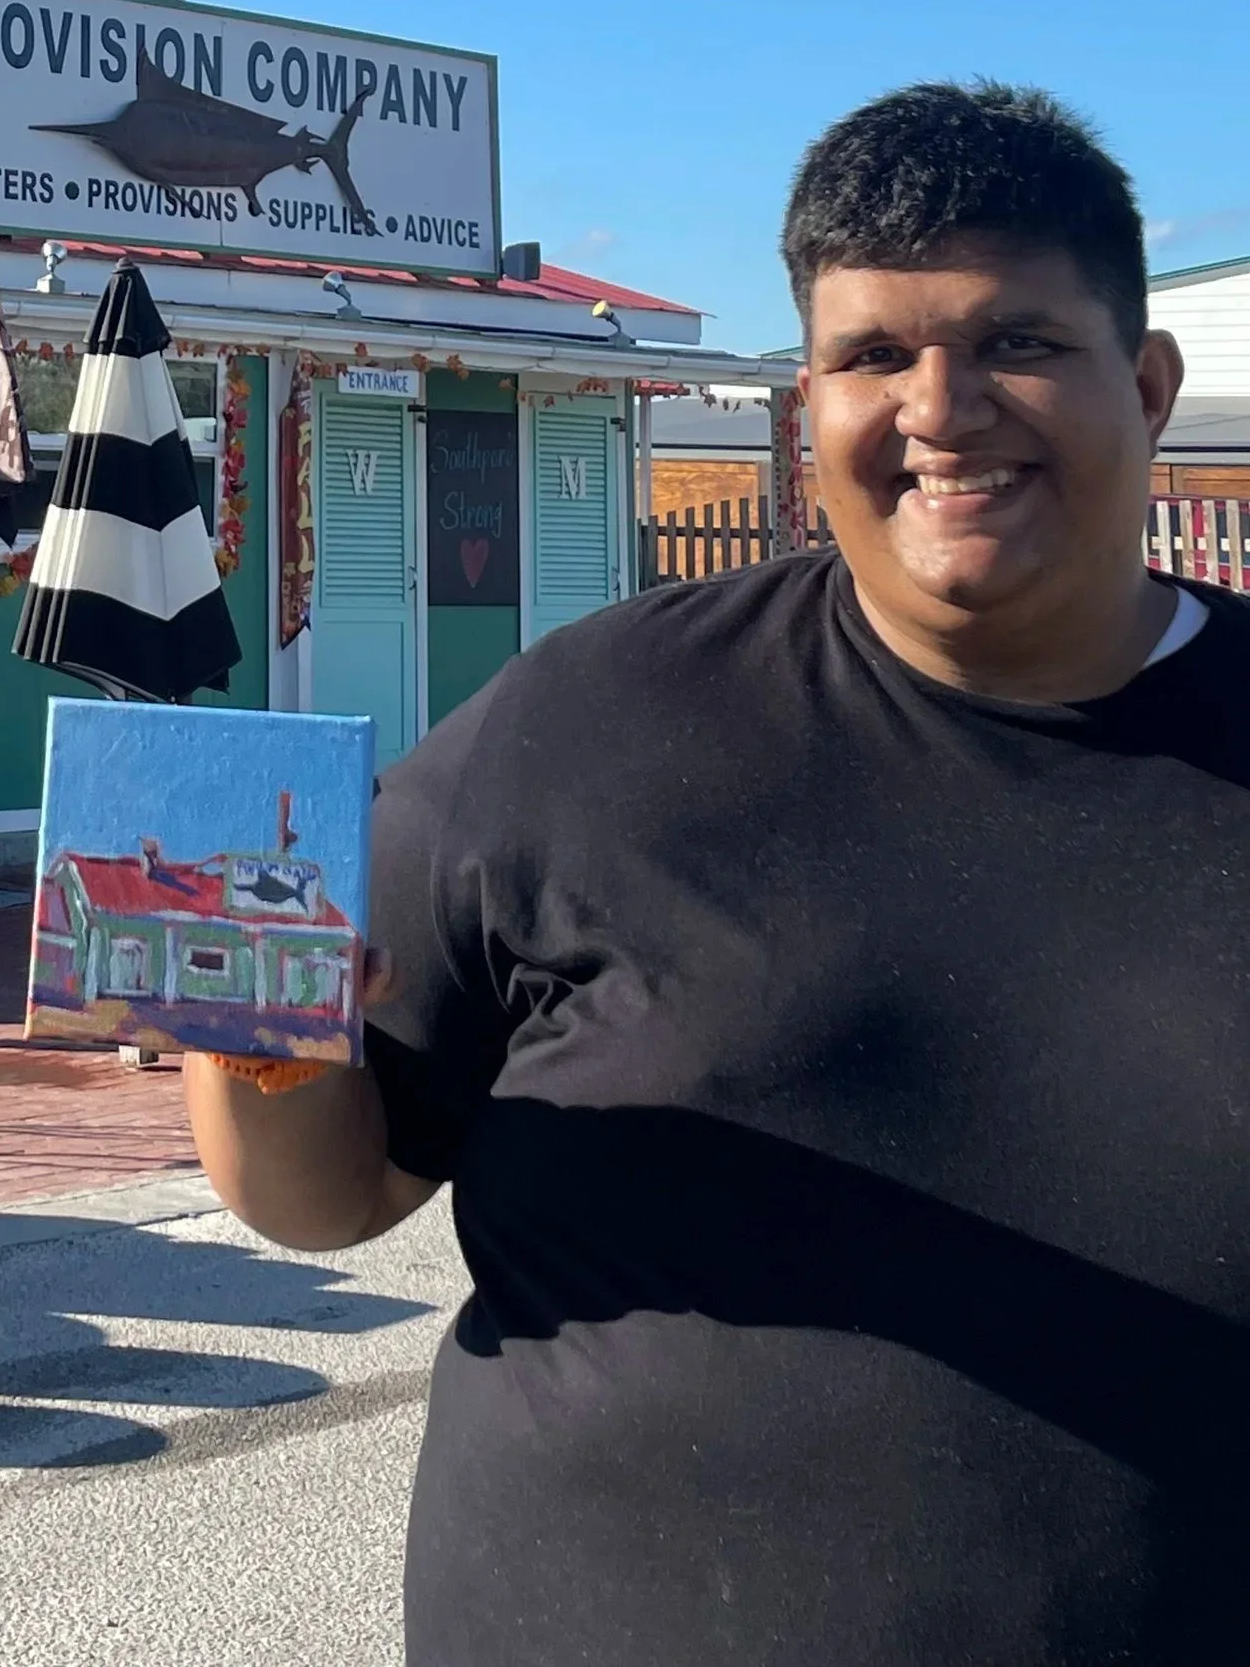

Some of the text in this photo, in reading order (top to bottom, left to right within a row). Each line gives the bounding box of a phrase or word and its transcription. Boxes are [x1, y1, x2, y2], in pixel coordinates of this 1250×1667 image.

[248, 40, 468, 132] COMPANY
[87, 178, 238, 222] PROVISIONS
[404, 213, 481, 249] ADVICE
[348, 371, 409, 394] ENTRANCE
[346, 449, 381, 496] W
[558, 455, 589, 500] M
[439, 490, 503, 539] Strong
